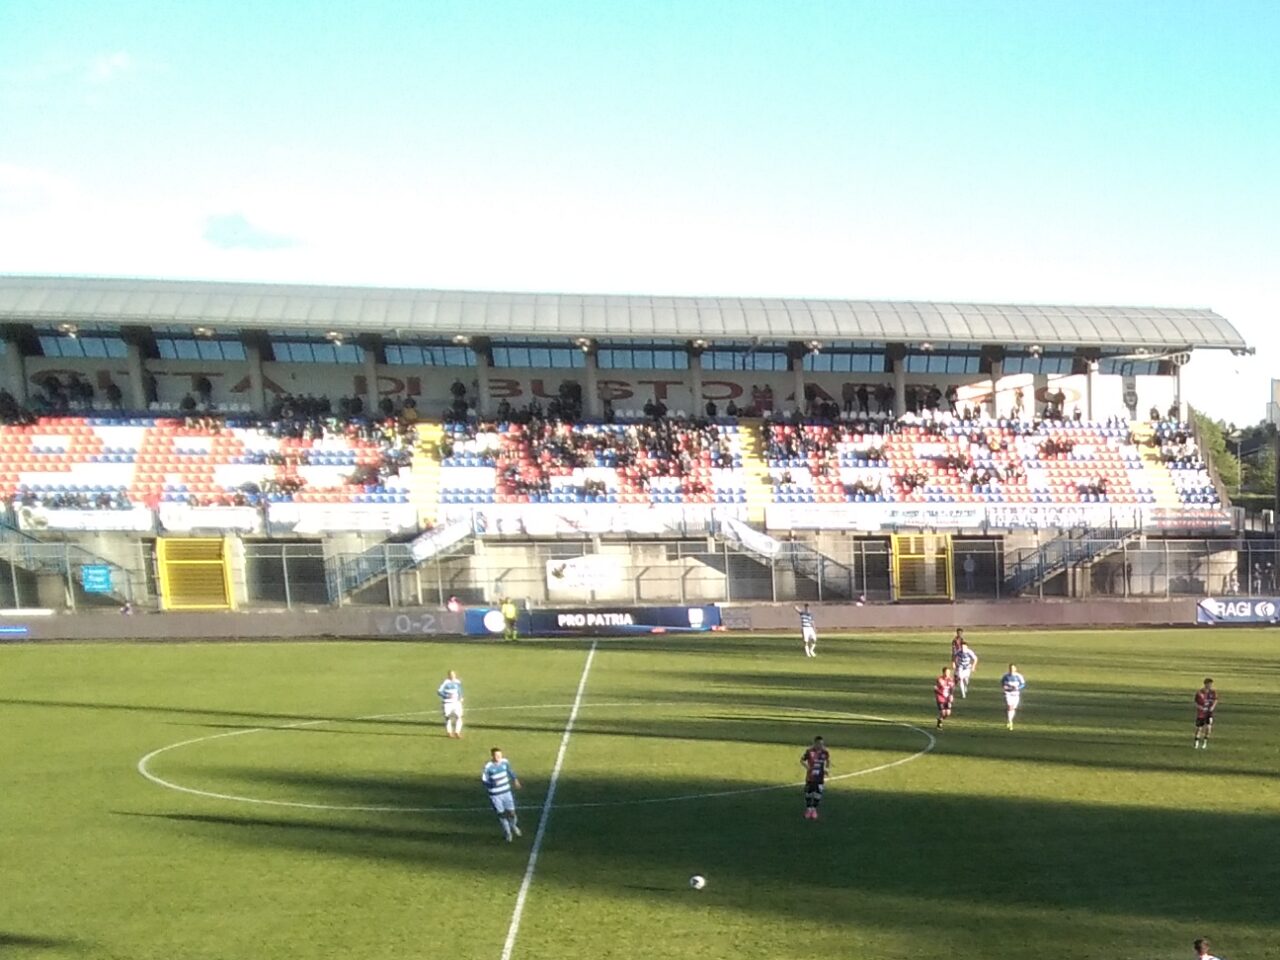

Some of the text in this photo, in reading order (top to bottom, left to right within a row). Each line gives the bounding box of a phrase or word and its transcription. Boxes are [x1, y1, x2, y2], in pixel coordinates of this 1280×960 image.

[1213, 600, 1252, 617] RAGI
[558, 613, 633, 627] PRO PATRIA
